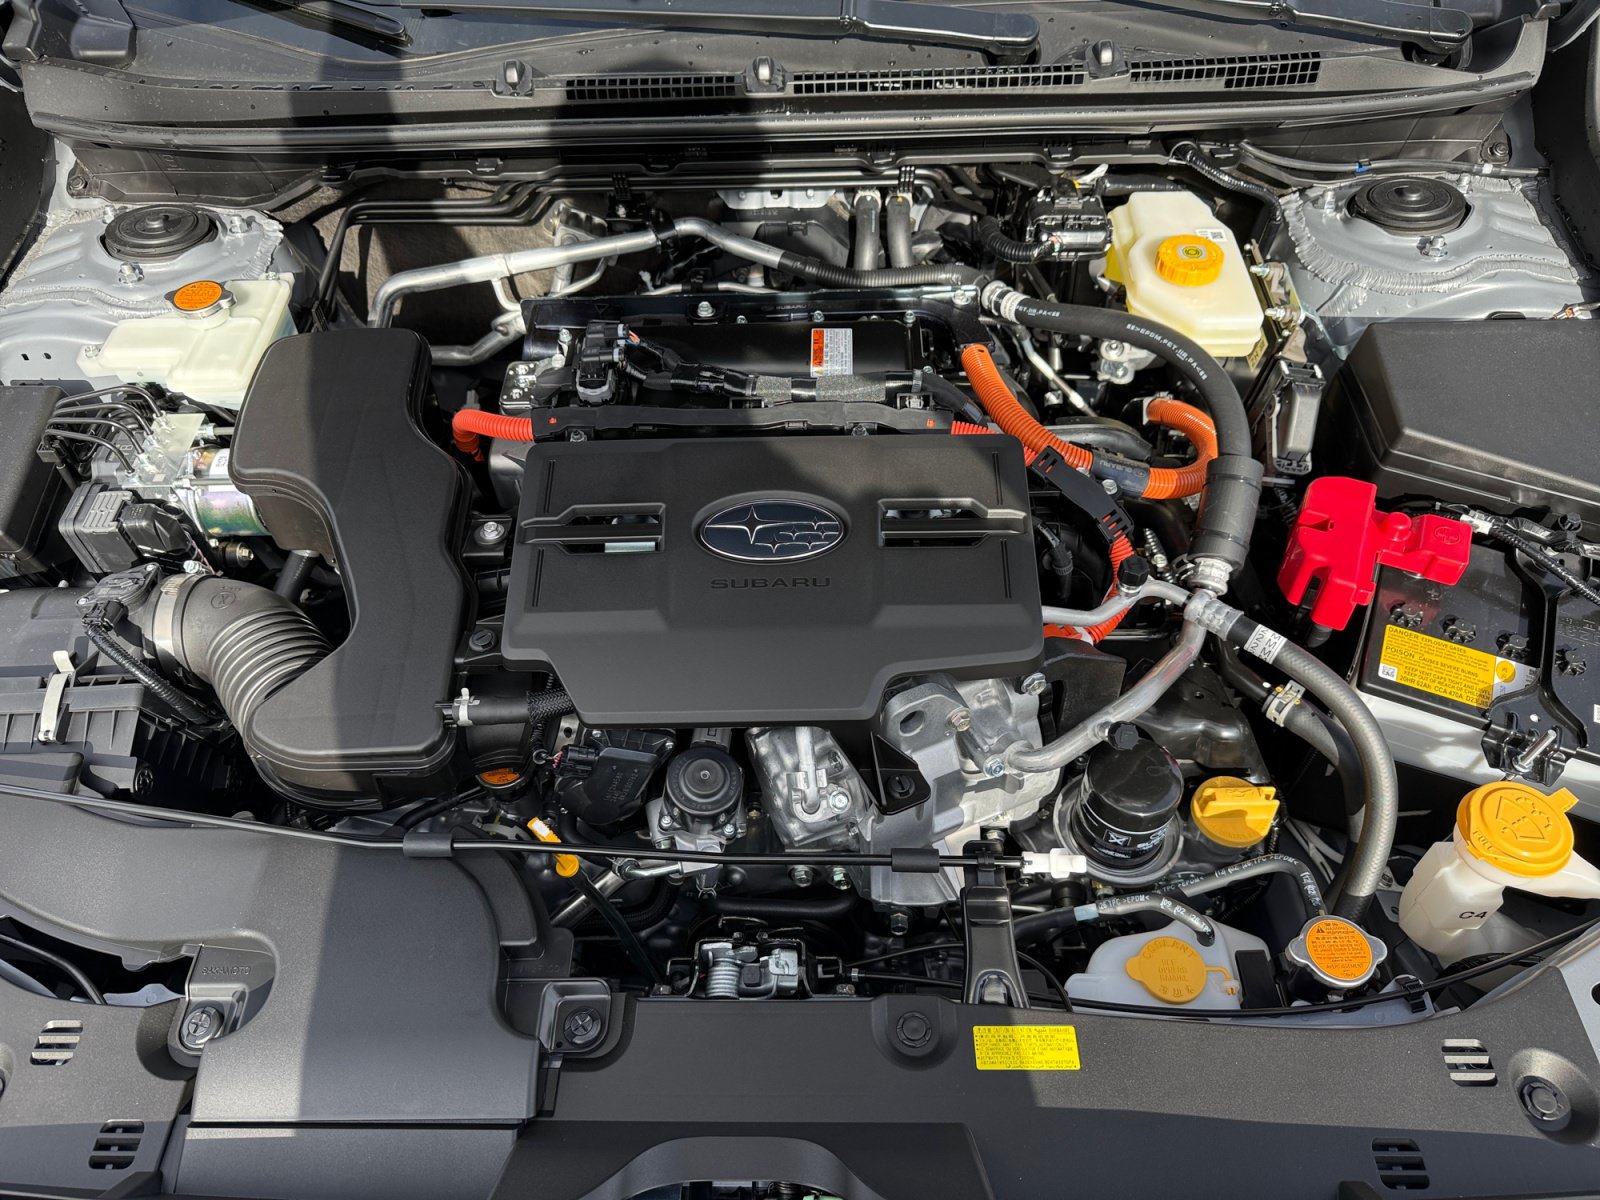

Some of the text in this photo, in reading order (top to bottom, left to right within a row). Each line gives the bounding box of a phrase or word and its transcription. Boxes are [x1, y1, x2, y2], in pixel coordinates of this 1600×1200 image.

[711, 577, 831, 589] SUBARU
[1388, 627, 1419, 640] DANGER
[1421, 636, 1449, 650] EXPLOSIVE
[1385, 645, 1415, 659] POISON
[1418, 655, 1440, 667] CAUSES
[1440, 661, 1460, 672] SEVERE
[1460, 667, 1479, 677] BURNS
[1399, 675, 1416, 686] 20HR
[1433, 685, 1449, 695] CCA
[1403, 670, 1418, 679] KEEP
[1418, 675, 1431, 683] OUT
[1437, 680, 1456, 690] REACH
[1464, 688, 1491, 700] CHILDREN
[1404, 665, 1418, 674] KEEP
[1418, 668, 1434, 677] VENT
[1433, 672, 1447, 682] CAPS
[1447, 676, 1463, 686] TIGHT
[1463, 681, 1475, 690] AND
[1458, 911, 1488, 919] C4
[1142, 939, 1197, 960] COOLANT
